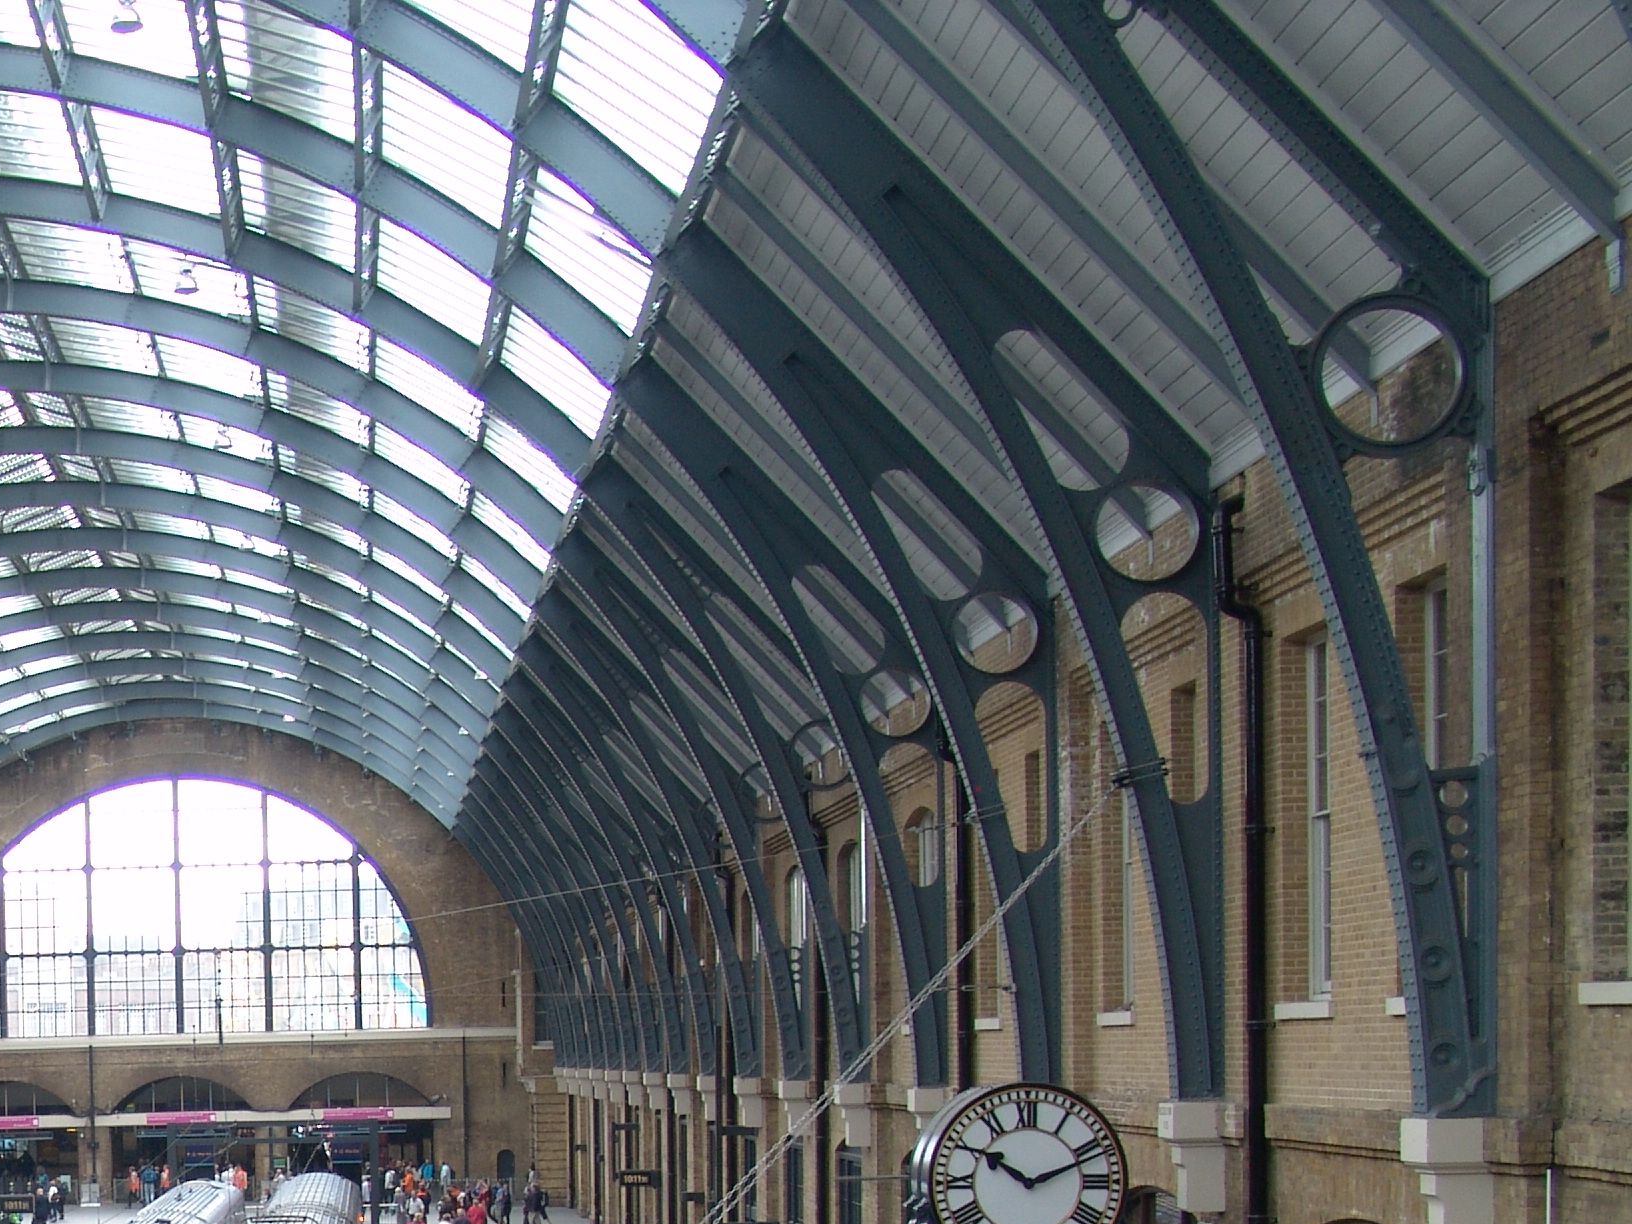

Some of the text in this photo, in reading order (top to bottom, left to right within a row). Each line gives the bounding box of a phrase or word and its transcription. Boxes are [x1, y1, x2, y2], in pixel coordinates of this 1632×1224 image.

[980, 1111, 1007, 1139] XI
[1015, 1102, 1038, 1129] XII
[1072, 1138, 1102, 1157] II
[947, 1173, 973, 1189] IX
[1083, 1174, 1109, 1189] III
